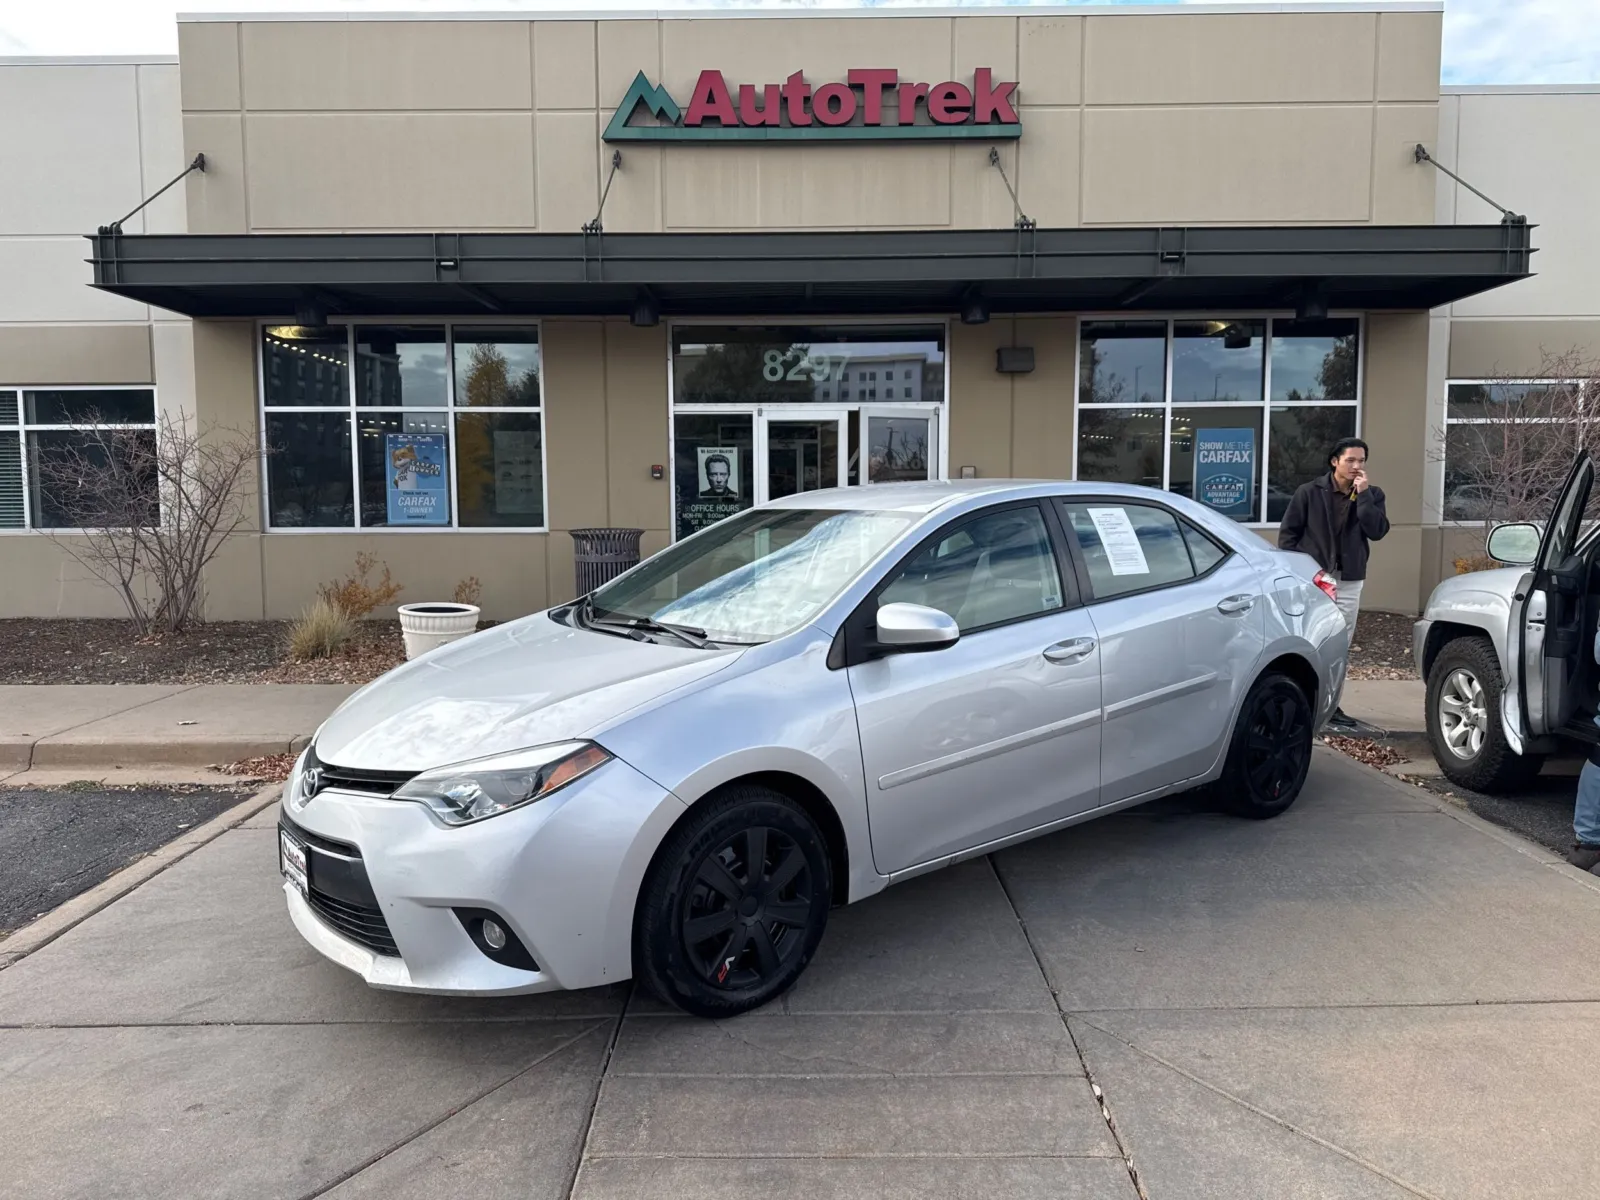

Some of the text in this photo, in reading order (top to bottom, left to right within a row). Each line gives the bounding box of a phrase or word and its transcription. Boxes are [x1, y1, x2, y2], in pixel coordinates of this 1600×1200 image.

[683, 67, 1020, 127] AutoTrek
[762, 349, 850, 382] 8297
[1200, 442, 1251, 450] SHOW ME THE
[1199, 450, 1251, 463] CARFAX
[398, 496, 437, 506] CARFAX
[690, 504, 714, 512] OFFICE
[716, 504, 740, 512] HOURS
